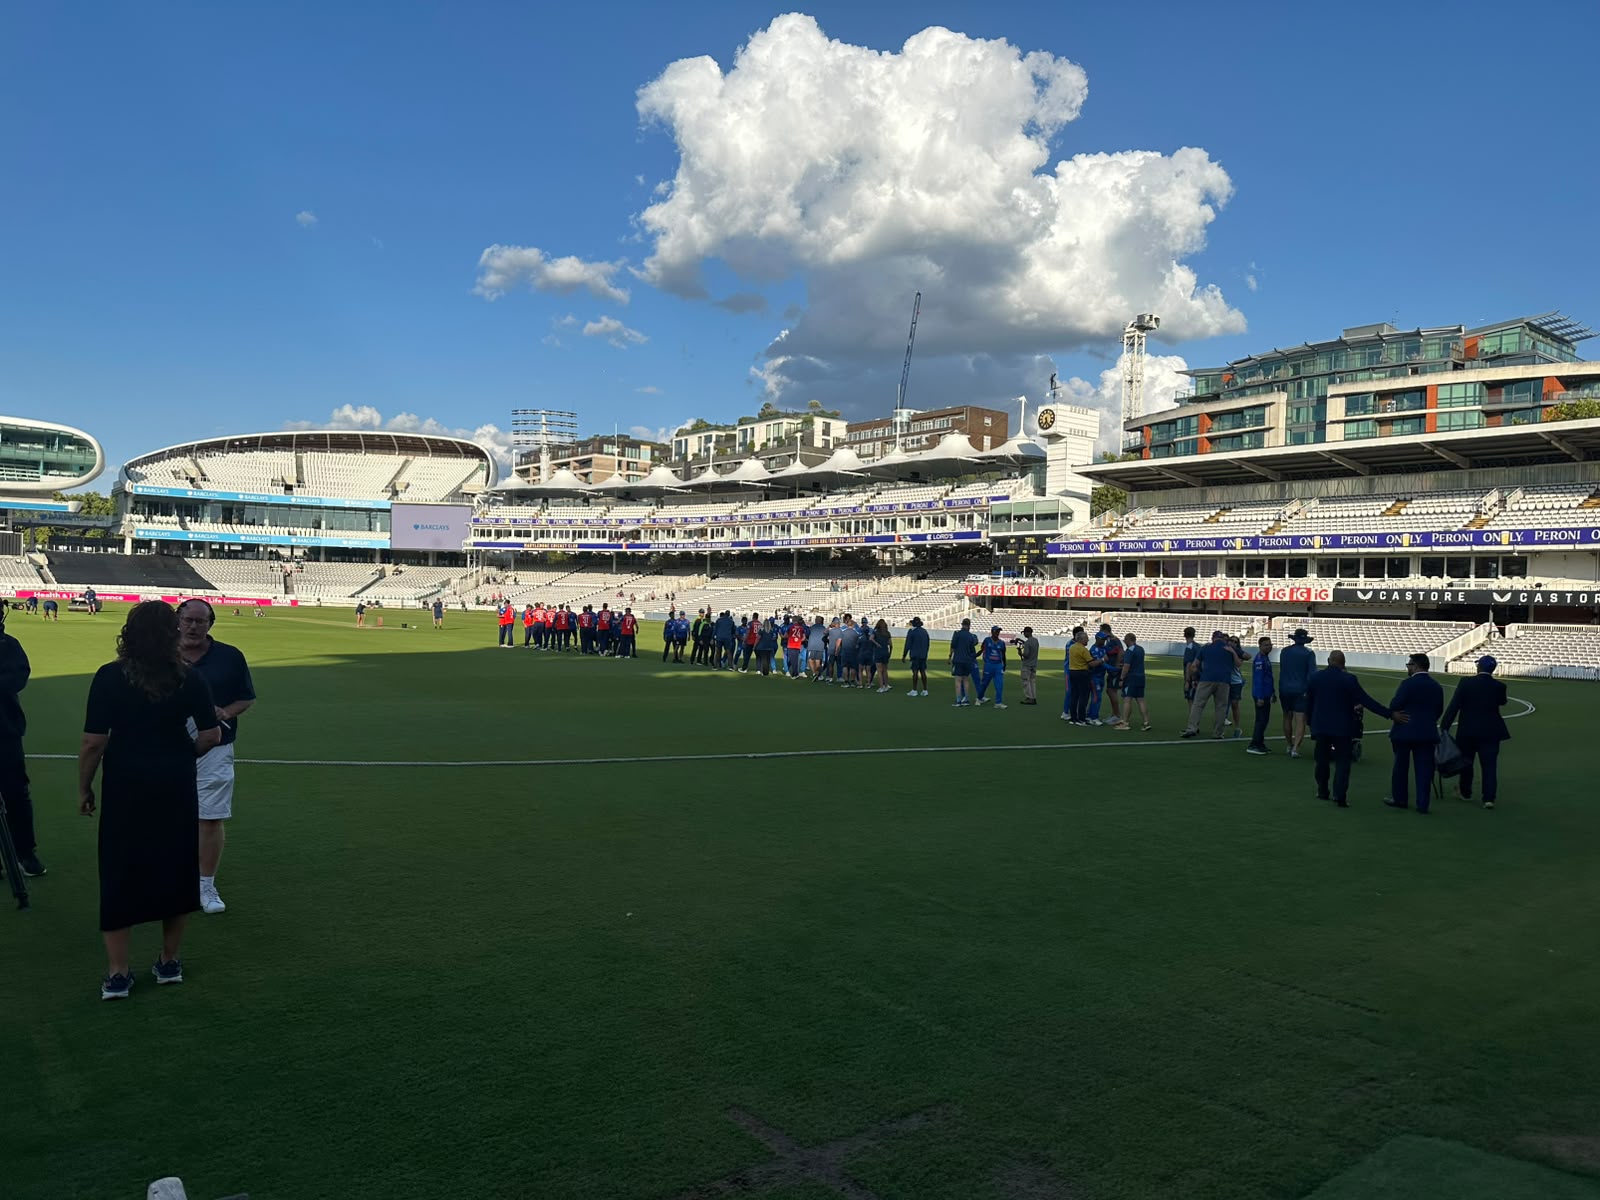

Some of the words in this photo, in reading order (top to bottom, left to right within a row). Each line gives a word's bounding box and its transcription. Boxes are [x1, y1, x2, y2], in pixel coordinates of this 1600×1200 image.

[1060, 543, 1084, 551] PERONI
[1119, 541, 1146, 550] PERONI
[1185, 539, 1216, 548] PERONI
[1259, 537, 1292, 547] PERONI
[1340, 535, 1378, 545] PERONI
[1431, 533, 1473, 543] PERONI
[1534, 530, 1581, 541] PERONI
[1379, 591, 1465, 602] CASTORE
[582, 616, 589, 624] 31
[792, 628, 801, 638] 24
